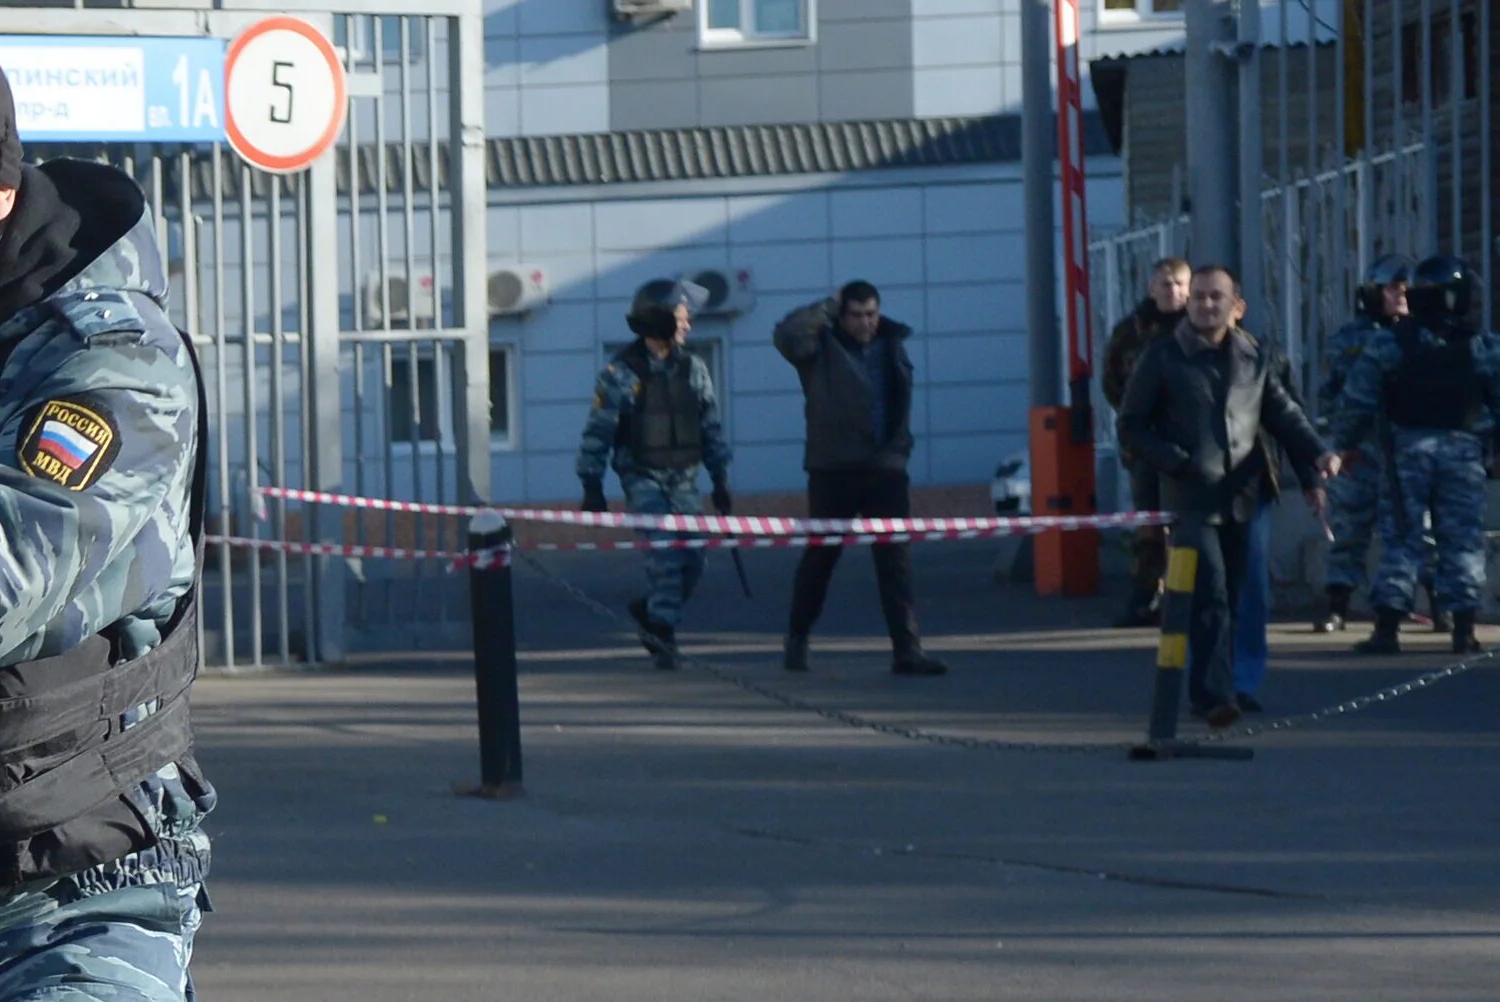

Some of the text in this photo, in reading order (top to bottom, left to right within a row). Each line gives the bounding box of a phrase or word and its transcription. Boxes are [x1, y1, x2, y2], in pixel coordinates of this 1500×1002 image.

[172, 53, 219, 128] 1А
[270, 61, 295, 124] 5
[46, 404, 110, 445] РОССИЯ
[32, 451, 73, 486] МВД
